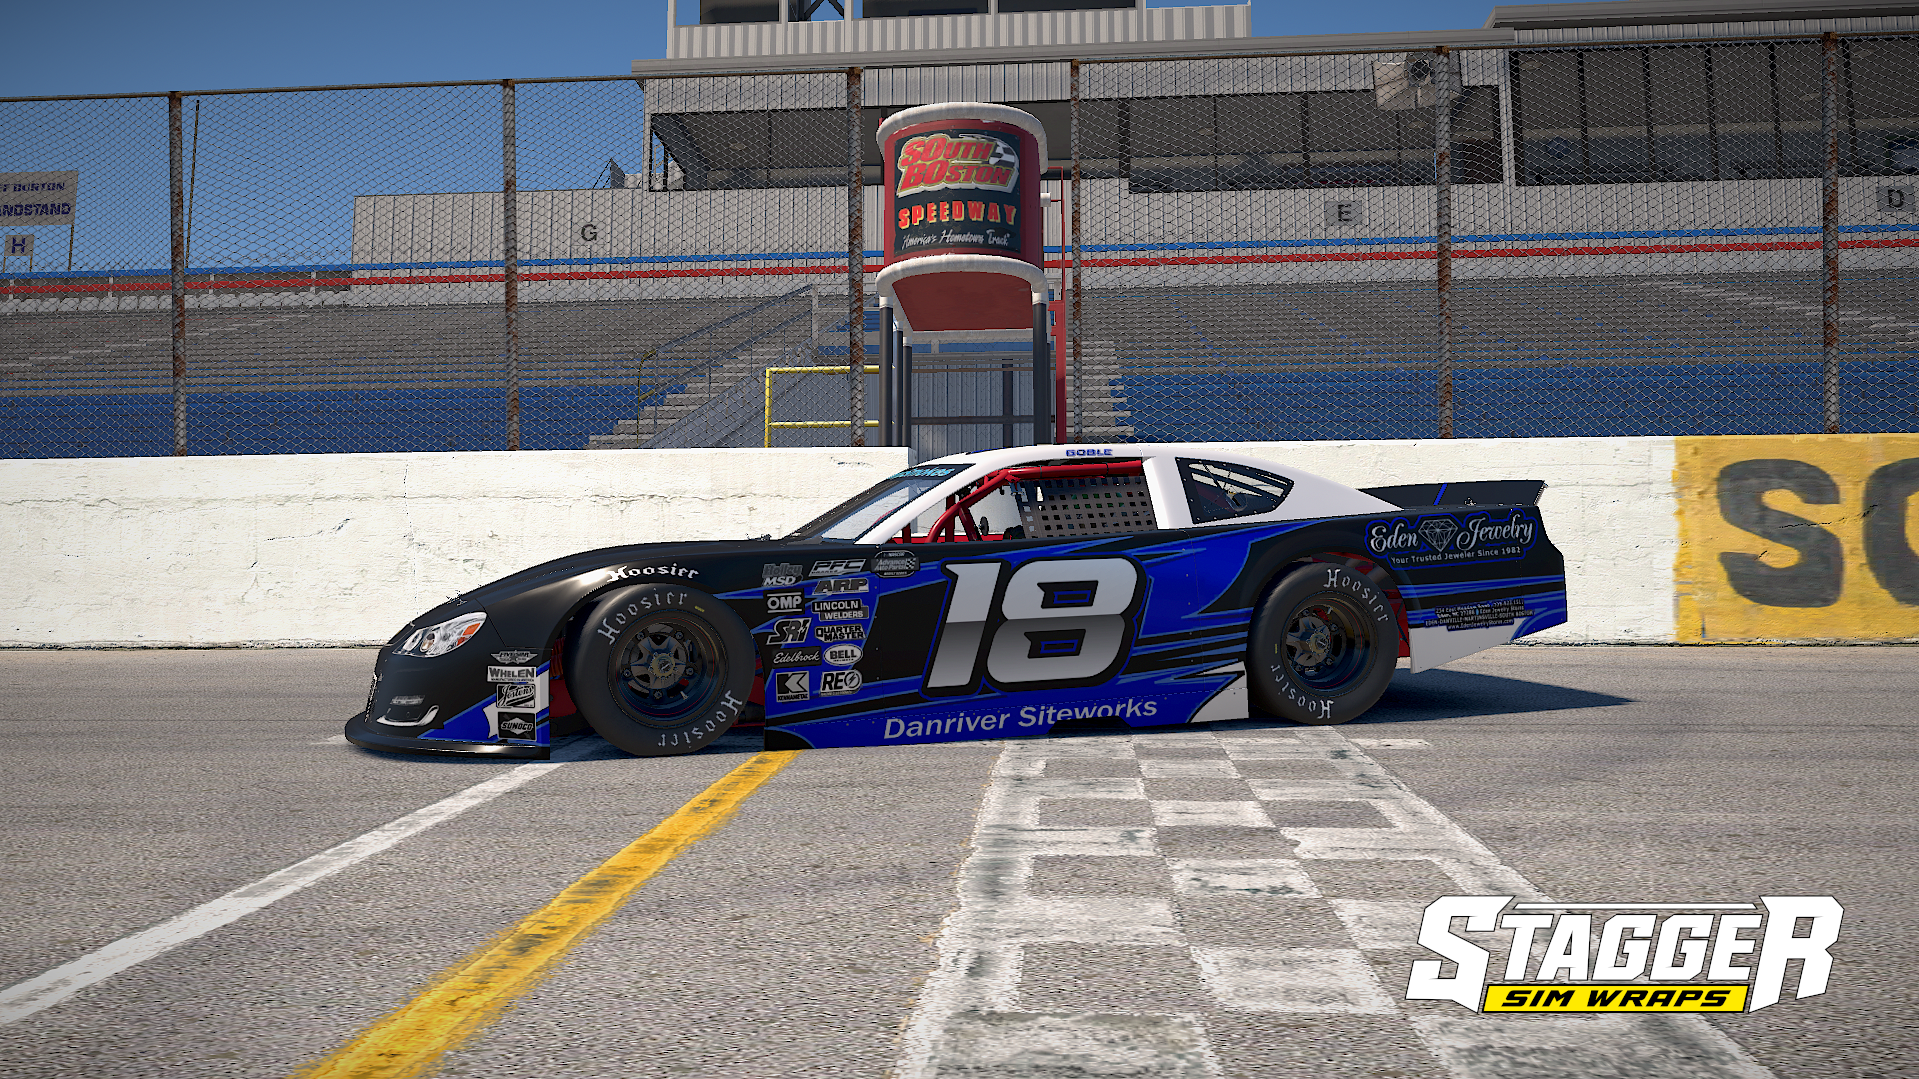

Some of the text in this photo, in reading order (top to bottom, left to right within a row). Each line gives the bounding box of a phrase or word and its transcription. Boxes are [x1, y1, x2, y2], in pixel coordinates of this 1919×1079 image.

[901, 137, 995, 167] SOUTH
[901, 160, 1015, 191] BOSTON
[13, 182, 65, 192] BURTON
[1887, 189, 1905, 208] D
[0, 202, 72, 217] NDSTAND
[898, 200, 1017, 229] SPEEDWAY
[1337, 204, 1353, 222] E
[580, 223, 598, 242] G
[939, 229, 985, 244] Hometown
[11, 236, 26, 254] H
[1065, 448, 1113, 457] GOBLE
[1370, 513, 1533, 553] Eden Jewelry
[1391, 556, 1409, 564] Your
[1411, 553, 1442, 563] Trusted
[1444, 550, 1475, 560] Jeweler
[1477, 548, 1499, 557] Since
[606, 562, 700, 583] Hoosier
[762, 563, 803, 578] Holley
[763, 576, 797, 586] MSD
[814, 578, 868, 593] ARP
[767, 596, 803, 610] OMP
[1323, 568, 1389, 623] Hoosier
[814, 600, 859, 611] LINCOLN
[597, 588, 688, 645] Hoosier
[824, 610, 864, 620] WELDERS
[925, 557, 1139, 690] 18
[815, 625, 862, 638] QUARTER
[823, 631, 864, 642] MASTER
[773, 651, 821, 665] Edelbrock
[830, 649, 858, 660] BELL
[488, 667, 535, 678] WHELEN
[1270, 664, 1334, 719] Hoosier
[501, 722, 533, 731] SUNOCO
[657, 690, 743, 749] Hoosier
[883, 698, 1158, 740] Danriver Siteworks
